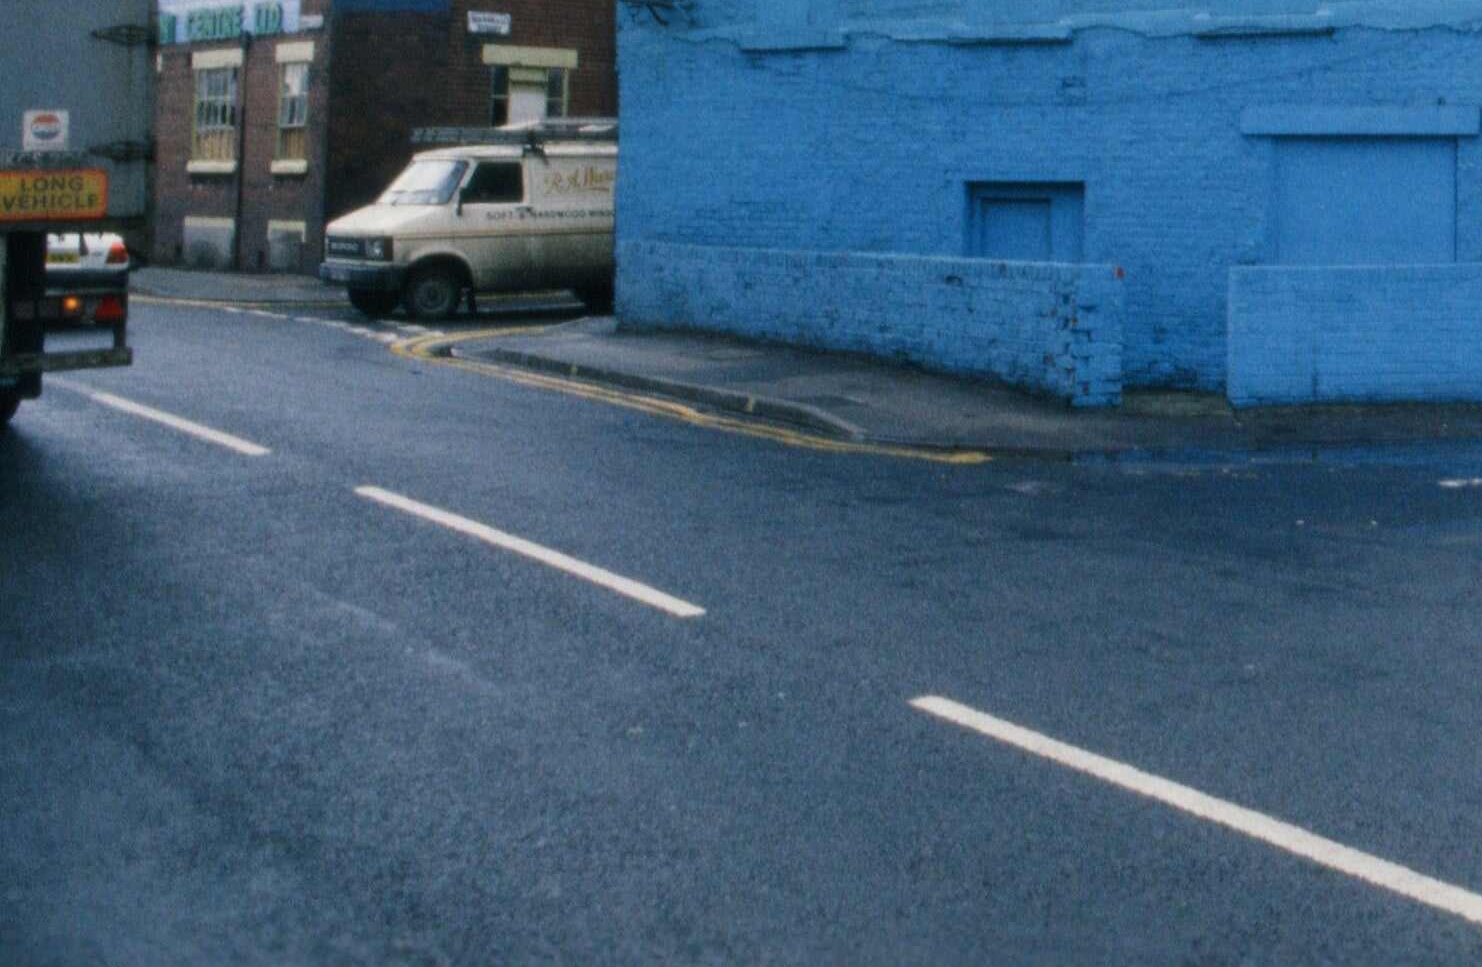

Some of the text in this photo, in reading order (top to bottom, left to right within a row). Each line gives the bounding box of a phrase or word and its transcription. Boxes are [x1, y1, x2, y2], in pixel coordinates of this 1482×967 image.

[185, 5, 244, 41] CENTRE
[20, 176, 83, 193] LONG
[2, 193, 99, 211] VEHICLE
